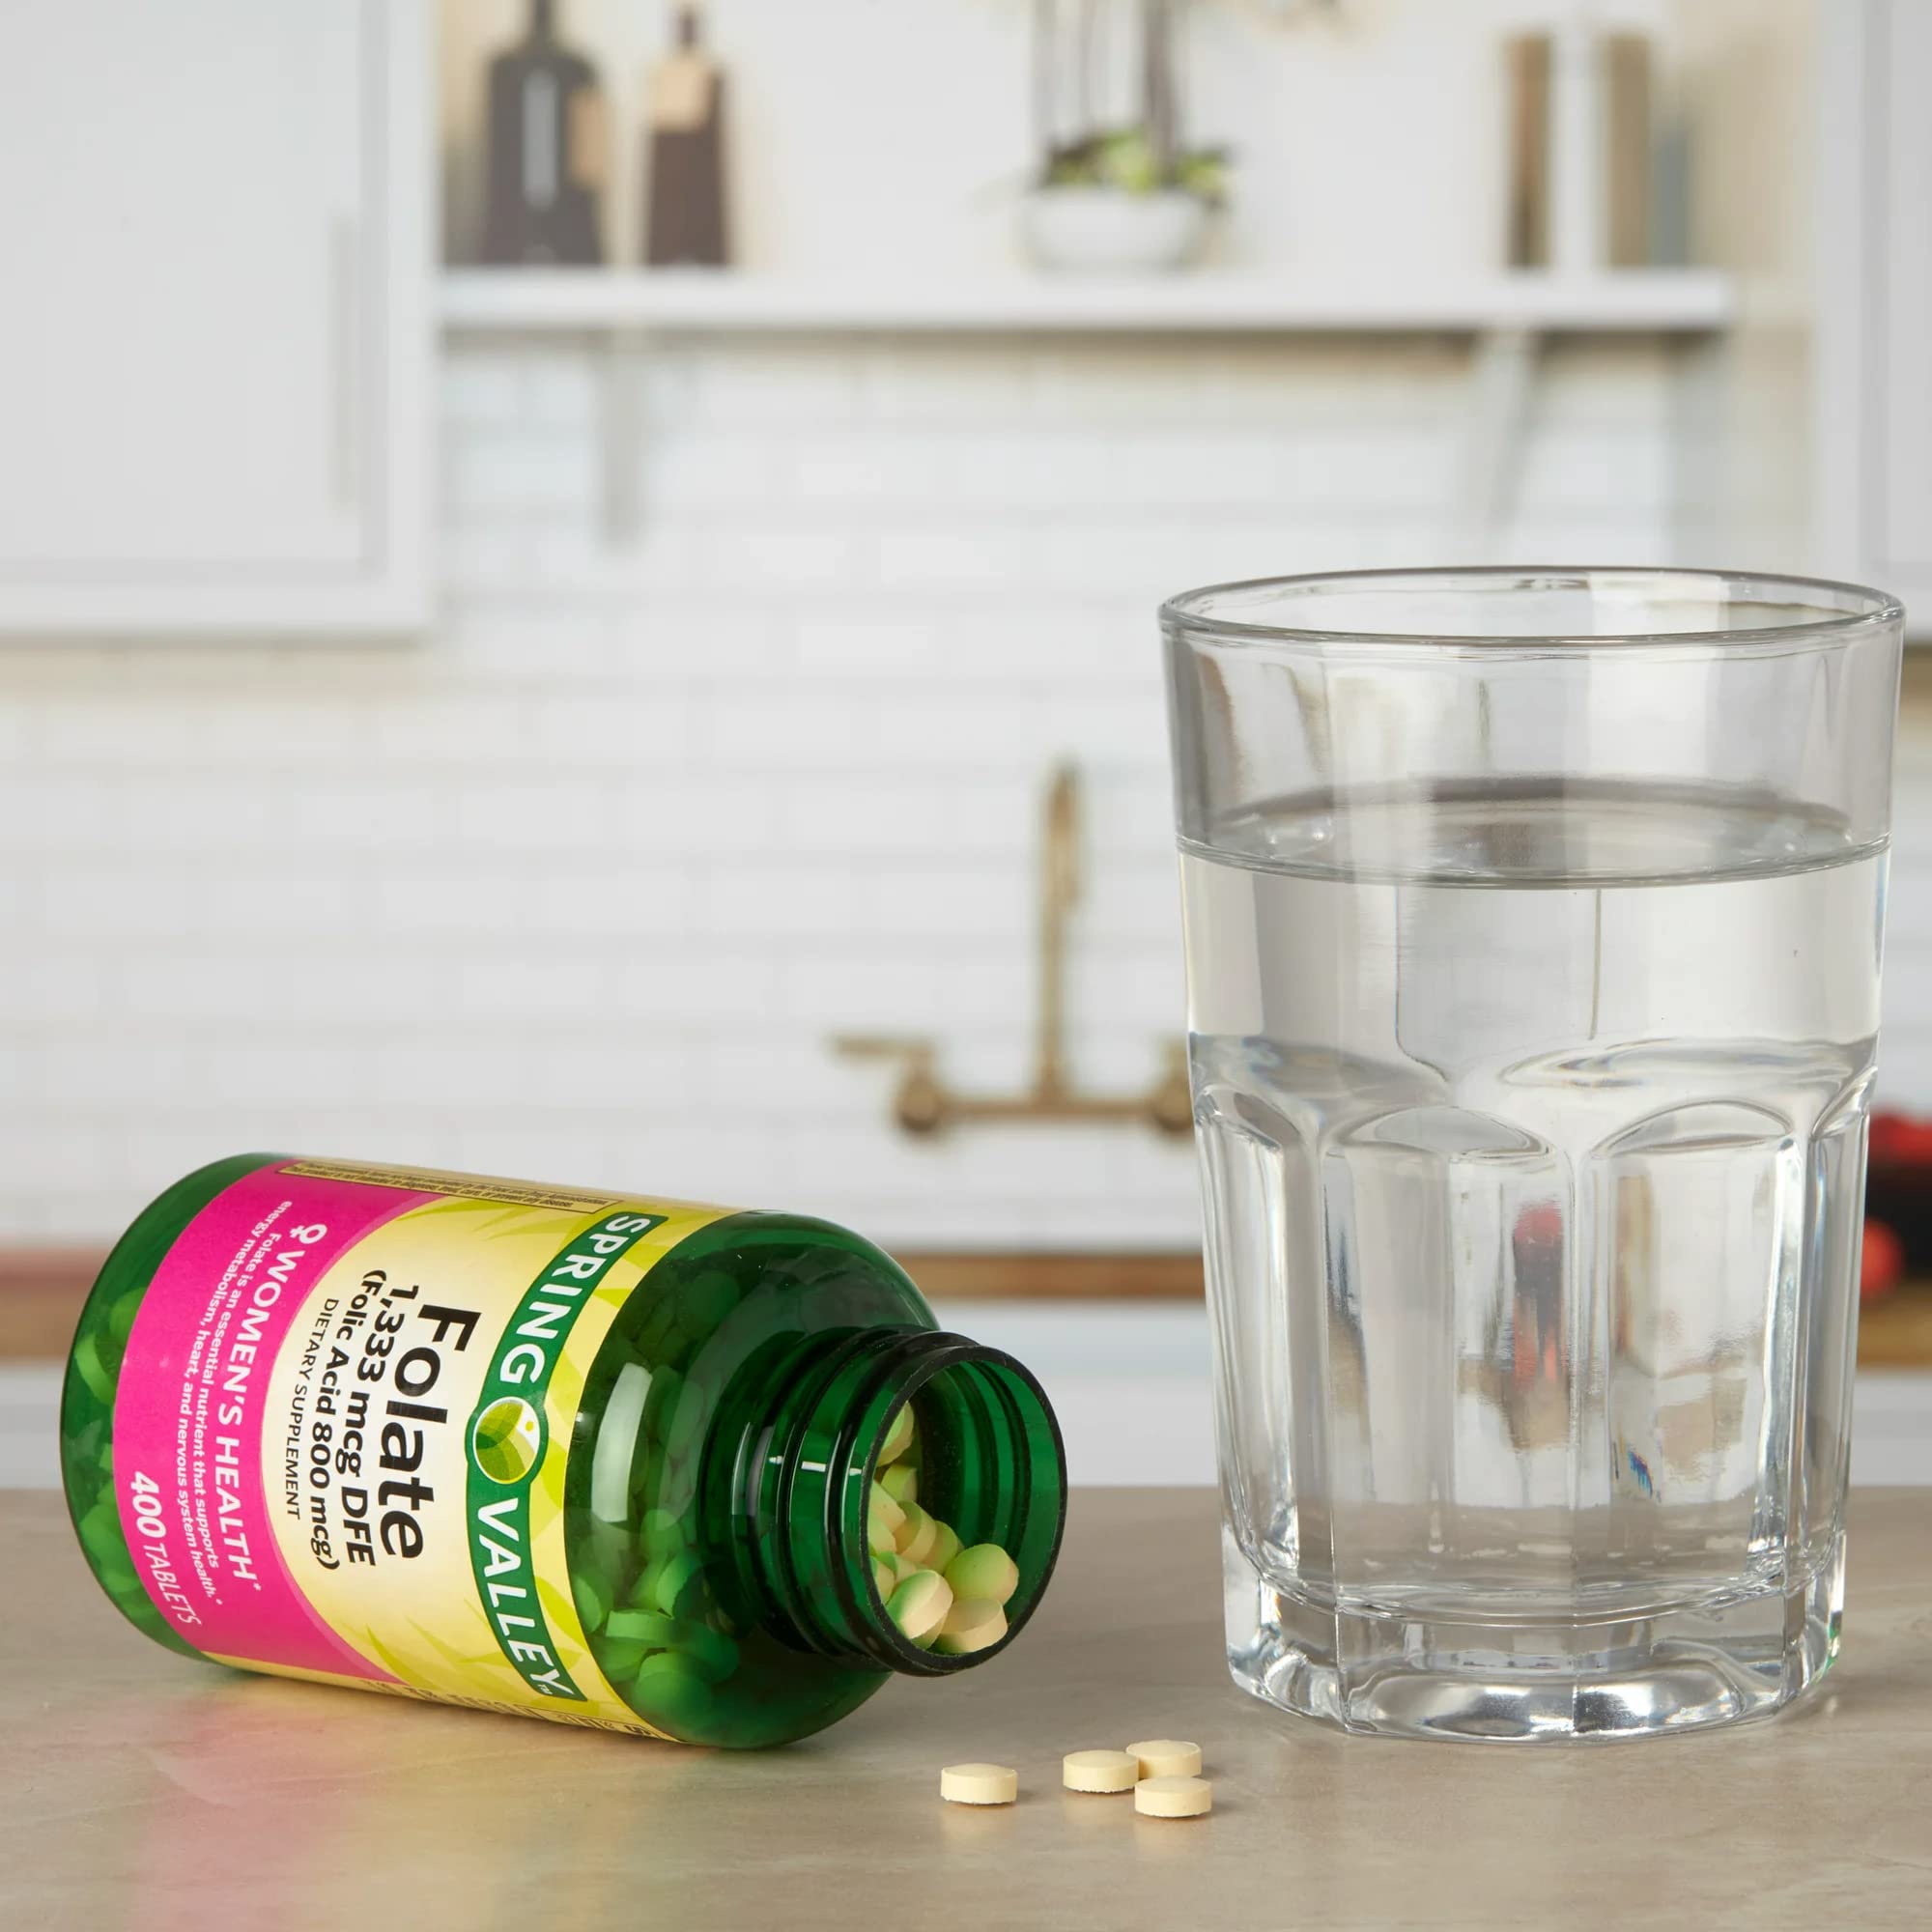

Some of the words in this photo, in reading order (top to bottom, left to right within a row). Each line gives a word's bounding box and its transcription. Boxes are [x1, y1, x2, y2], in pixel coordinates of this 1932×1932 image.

[245, 1233, 282, 1272] Folate
[251, 1201, 293, 1237] energy
[200, 1239, 256, 1326] metabolism,
[226, 1290, 242, 1308] an
[237, 1274, 253, 1288] is
[336, 1269, 386, 1340] (Folic
[499, 1215, 652, 1384] SPRING
[184, 1329, 211, 1378] heart,
[202, 1312, 231, 1385] essential
[217, 1251, 305, 1426] WOMEN'S
[298, 1298, 339, 1380] DIETARY
[356, 1285, 419, 1382] 1,333
[180, 1381, 194, 1416] and
[315, 1346, 350, 1415] Acid
[177, 1418, 188, 1487] nervous
[193, 1388, 210, 1457] nutrient
[286, 1383, 308, 1520] SUPPLEMENT
[309, 1421, 333, 1489] 800
[335, 1391, 370, 1477] mcg
[378, 1304, 482, 1558] Folate
[130, 1470, 167, 1538] 400
[193, 1460, 207, 1496] that
[177, 1490, 197, 1548] system
[195, 1498, 219, 1569] supports
[310, 1495, 340, 1570] mcg)
[341, 1486, 376, 1566] DFE
[143, 1543, 202, 1625] TABLETS
[477, 1497, 575, 1695] VALLEY
